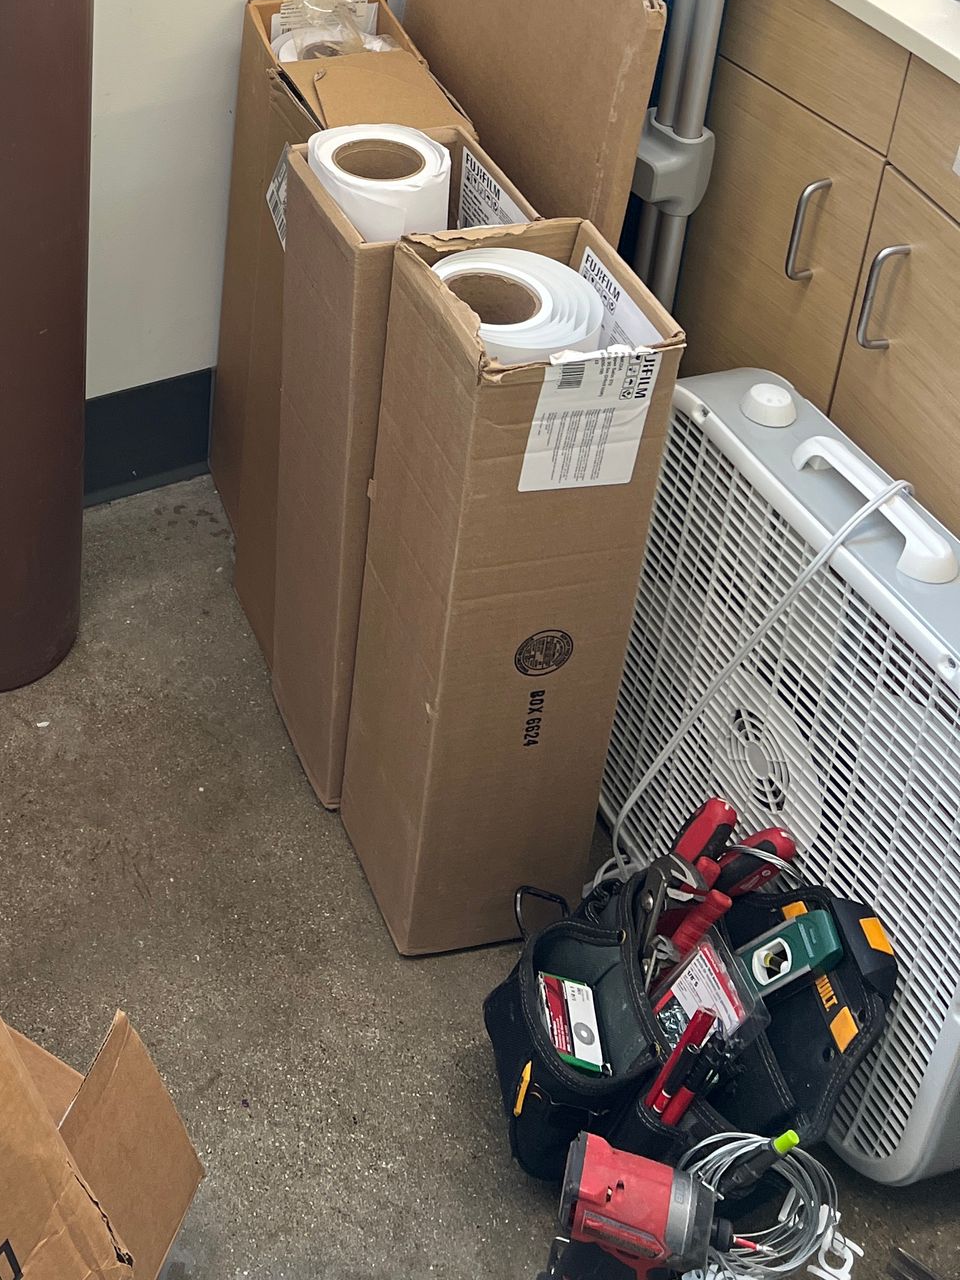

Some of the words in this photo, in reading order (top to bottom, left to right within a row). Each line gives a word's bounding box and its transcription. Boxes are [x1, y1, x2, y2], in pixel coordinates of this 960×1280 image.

[466, 153, 500, 201] FUJIFILM
[585, 254, 621, 303] FUJIFILM
[527, 689, 545, 715] BOX
[522, 717, 542, 748] 6624
